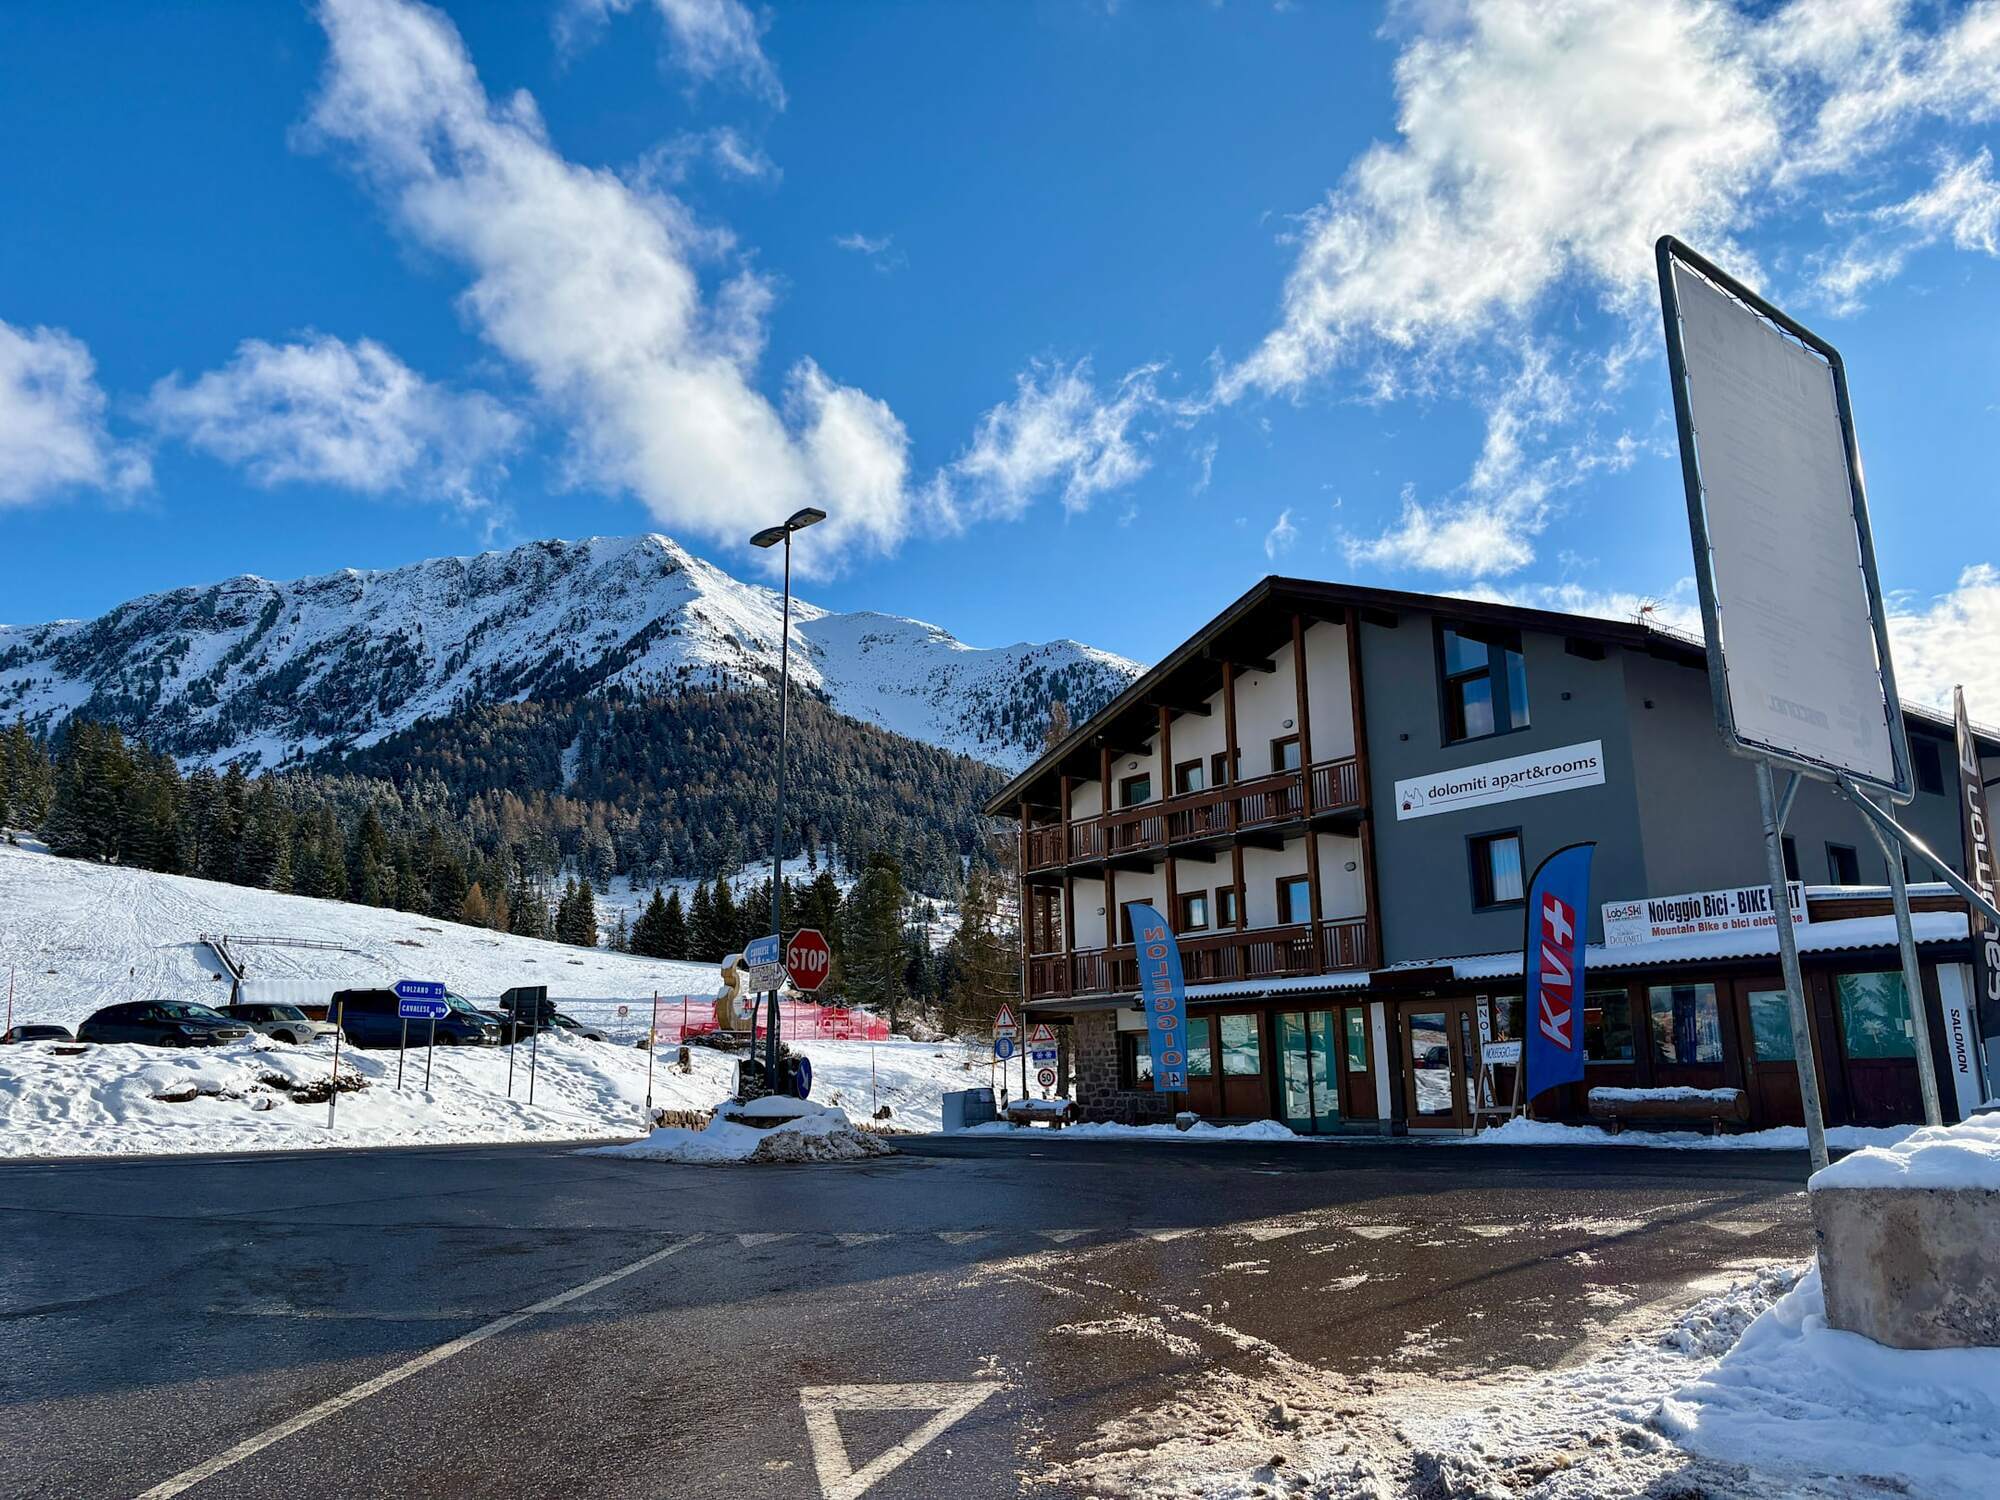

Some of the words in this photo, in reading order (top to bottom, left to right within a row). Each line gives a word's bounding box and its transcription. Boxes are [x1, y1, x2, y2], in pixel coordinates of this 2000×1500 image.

[1428, 776, 1488, 799] dolomiti
[1491, 757, 1597, 788] apart&rooms
[1648, 897, 1701, 923] Noleggio
[1704, 893, 1729, 918] Bici
[1737, 889, 1767, 914] BIKE
[1652, 924, 1696, 937] Mountain
[1698, 922, 1719, 932] Bike
[1722, 922, 1729, 930] e
[1732, 917, 1750, 929] bici
[789, 946, 828, 972] STOP
[1540, 899, 1573, 1049] KV+
[402, 985, 429, 994] BOLZANO
[401, 1004, 430, 1013] CAVALESE
[1950, 1008, 1969, 1074] SALOMON
[1041, 1073, 1052, 1082] 50
